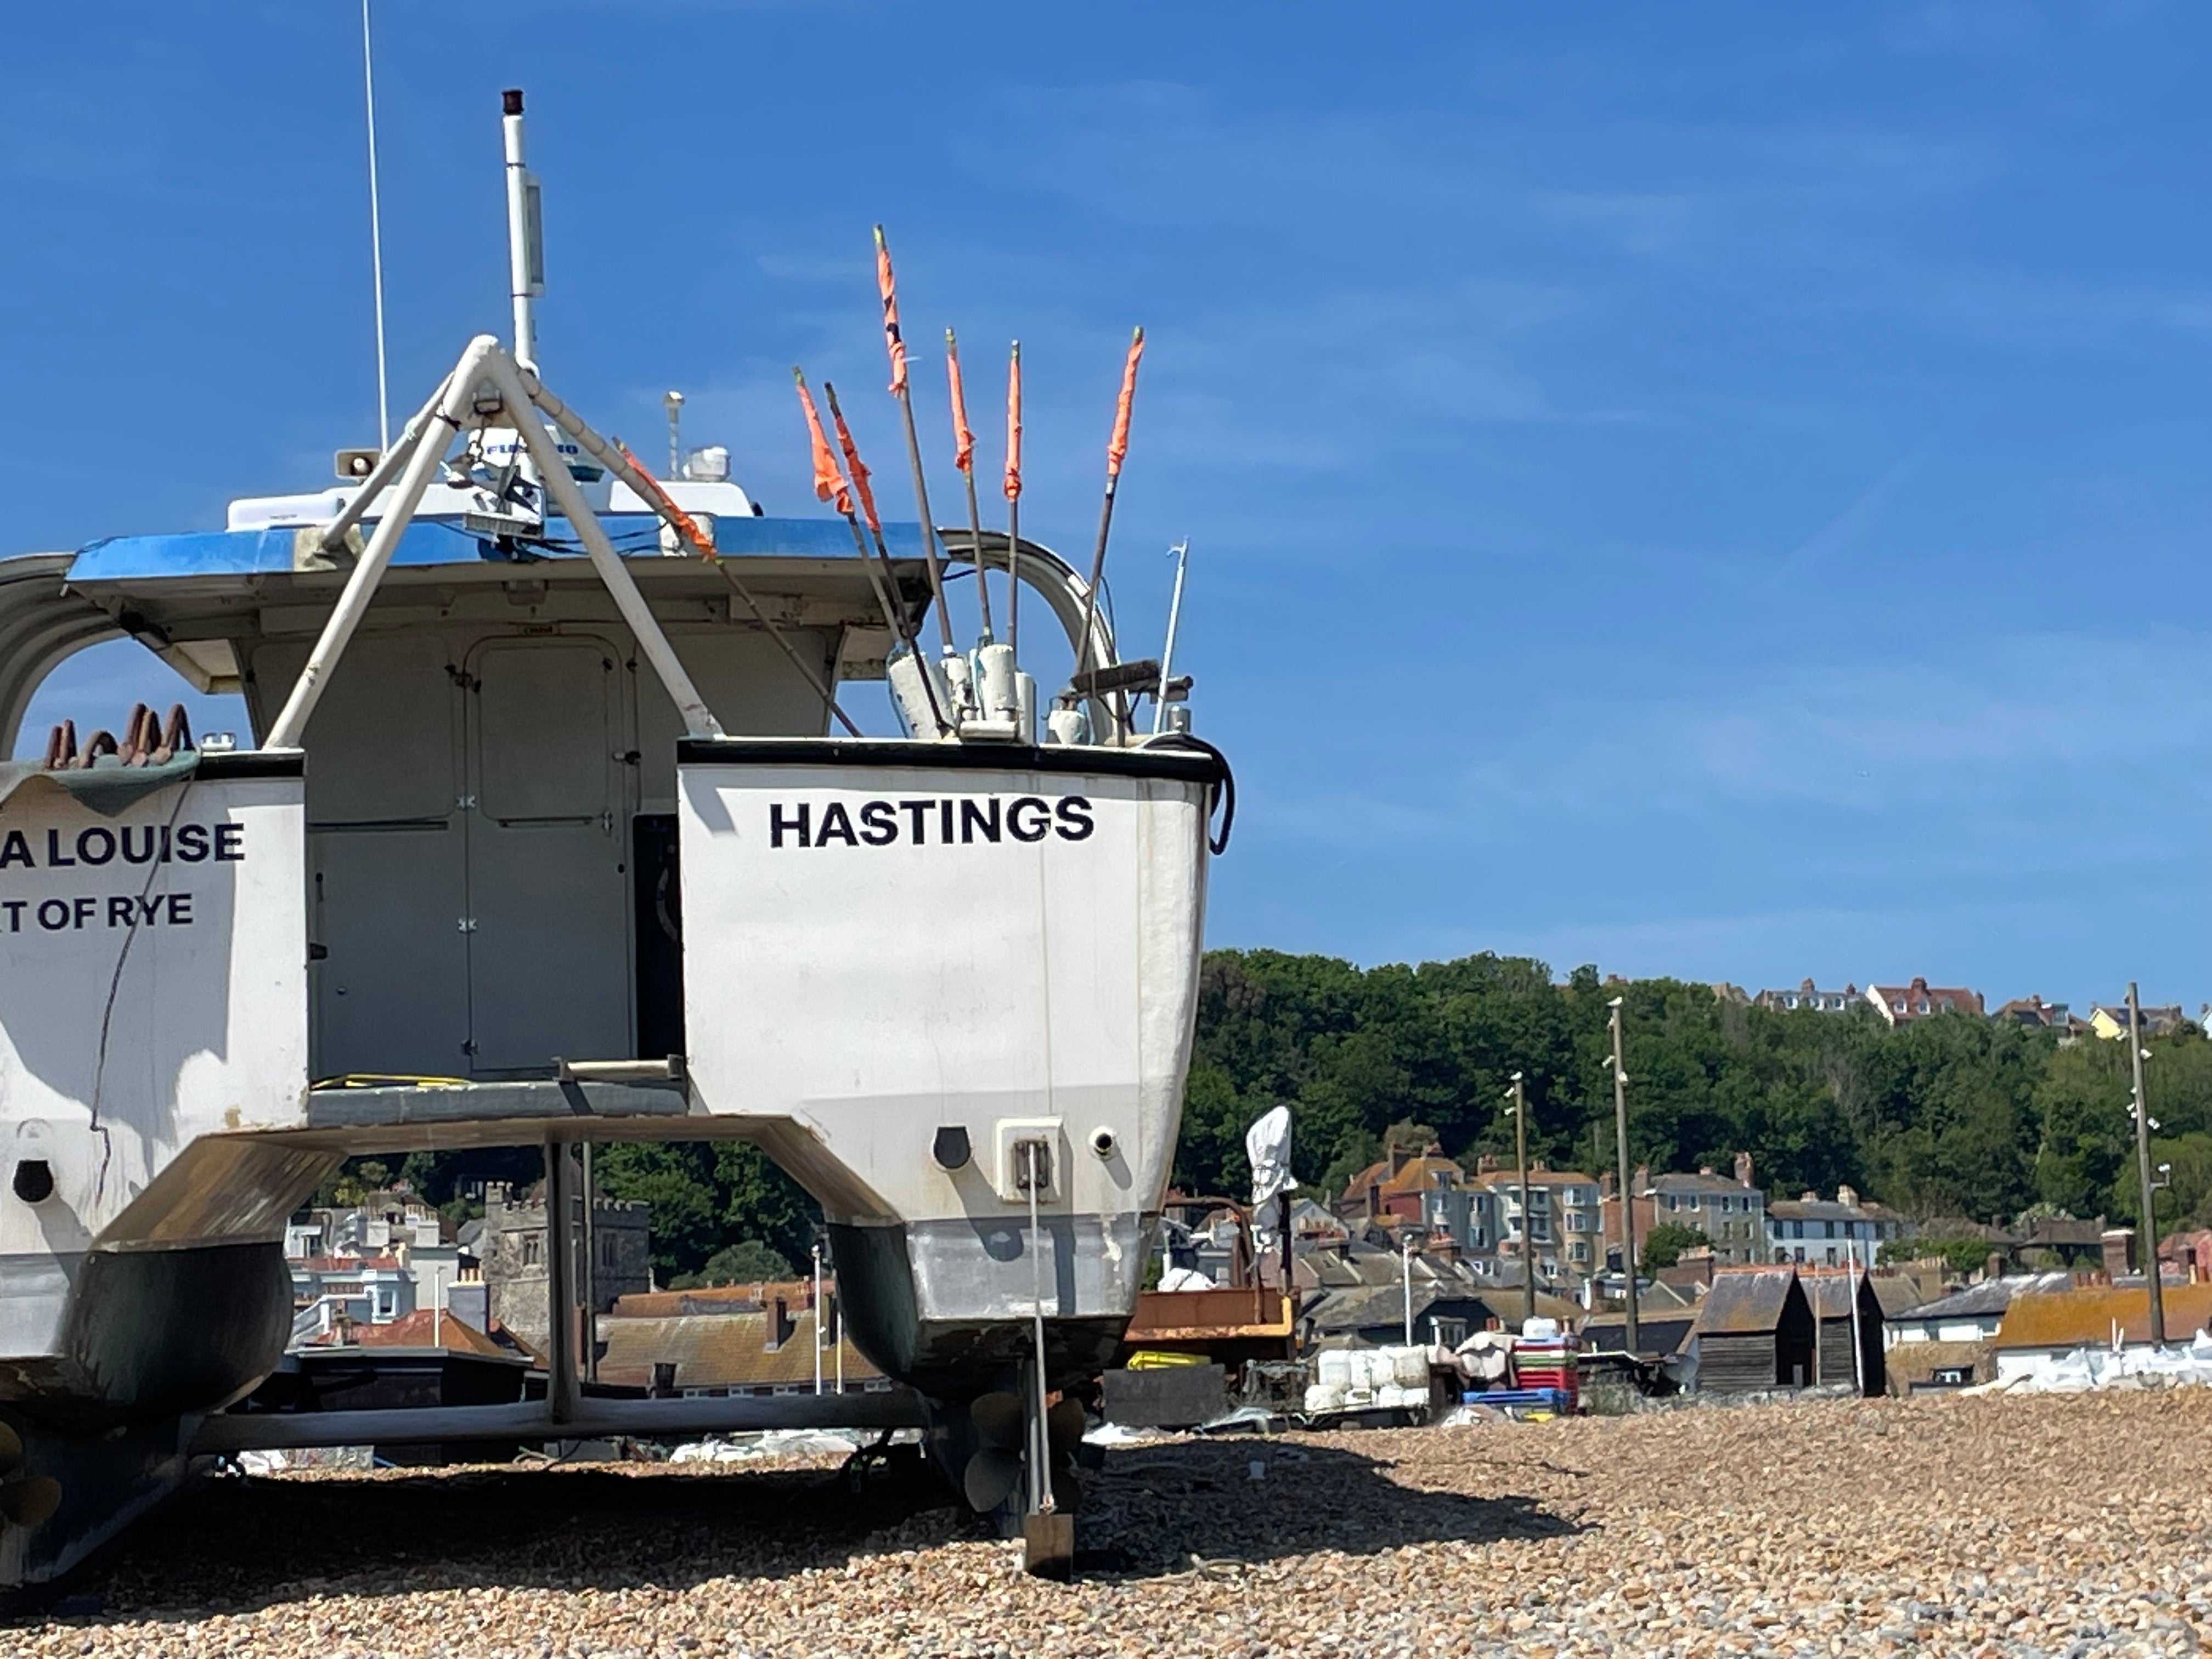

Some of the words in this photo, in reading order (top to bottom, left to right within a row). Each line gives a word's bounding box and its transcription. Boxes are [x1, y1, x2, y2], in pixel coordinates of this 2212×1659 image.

[770, 795, 1094, 848] HASTINGS
[48, 824, 244, 866] LOUISE
[0, 900, 27, 932] T
[37, 897, 97, 929] OF
[108, 894, 193, 928] RYE
